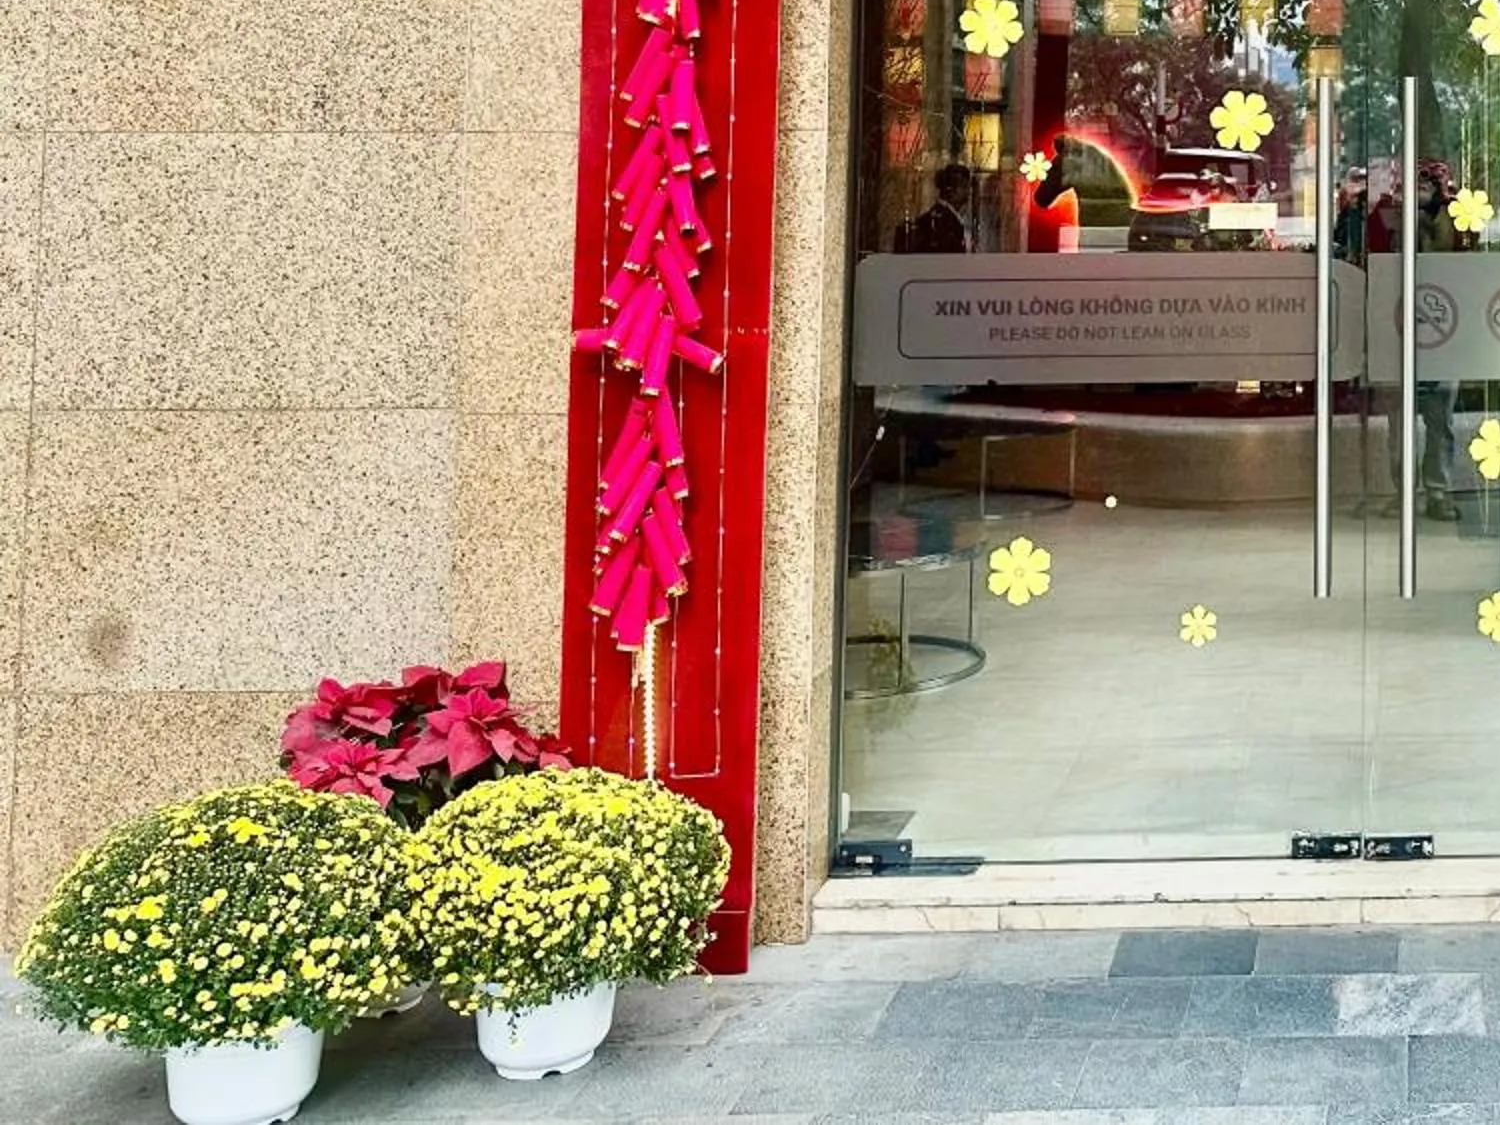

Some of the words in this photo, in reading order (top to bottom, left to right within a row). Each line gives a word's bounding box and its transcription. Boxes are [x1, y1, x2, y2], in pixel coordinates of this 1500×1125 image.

[934, 299, 972, 316] XIN
[977, 299, 1012, 316] VUI
[1018, 294, 1075, 316] LÒNG
[1079, 293, 1153, 316] KHÔNG
[1159, 297, 1203, 318] DỰA
[1208, 293, 1250, 315] VÀO
[1255, 295, 1307, 314] KÍNH
[988, 326, 1053, 342] PLEASE
[1056, 326, 1080, 341] DO
[1084, 325, 1118, 340] NOT
[1122, 325, 1166, 340] LEAN
[1170, 325, 1193, 340] ON
